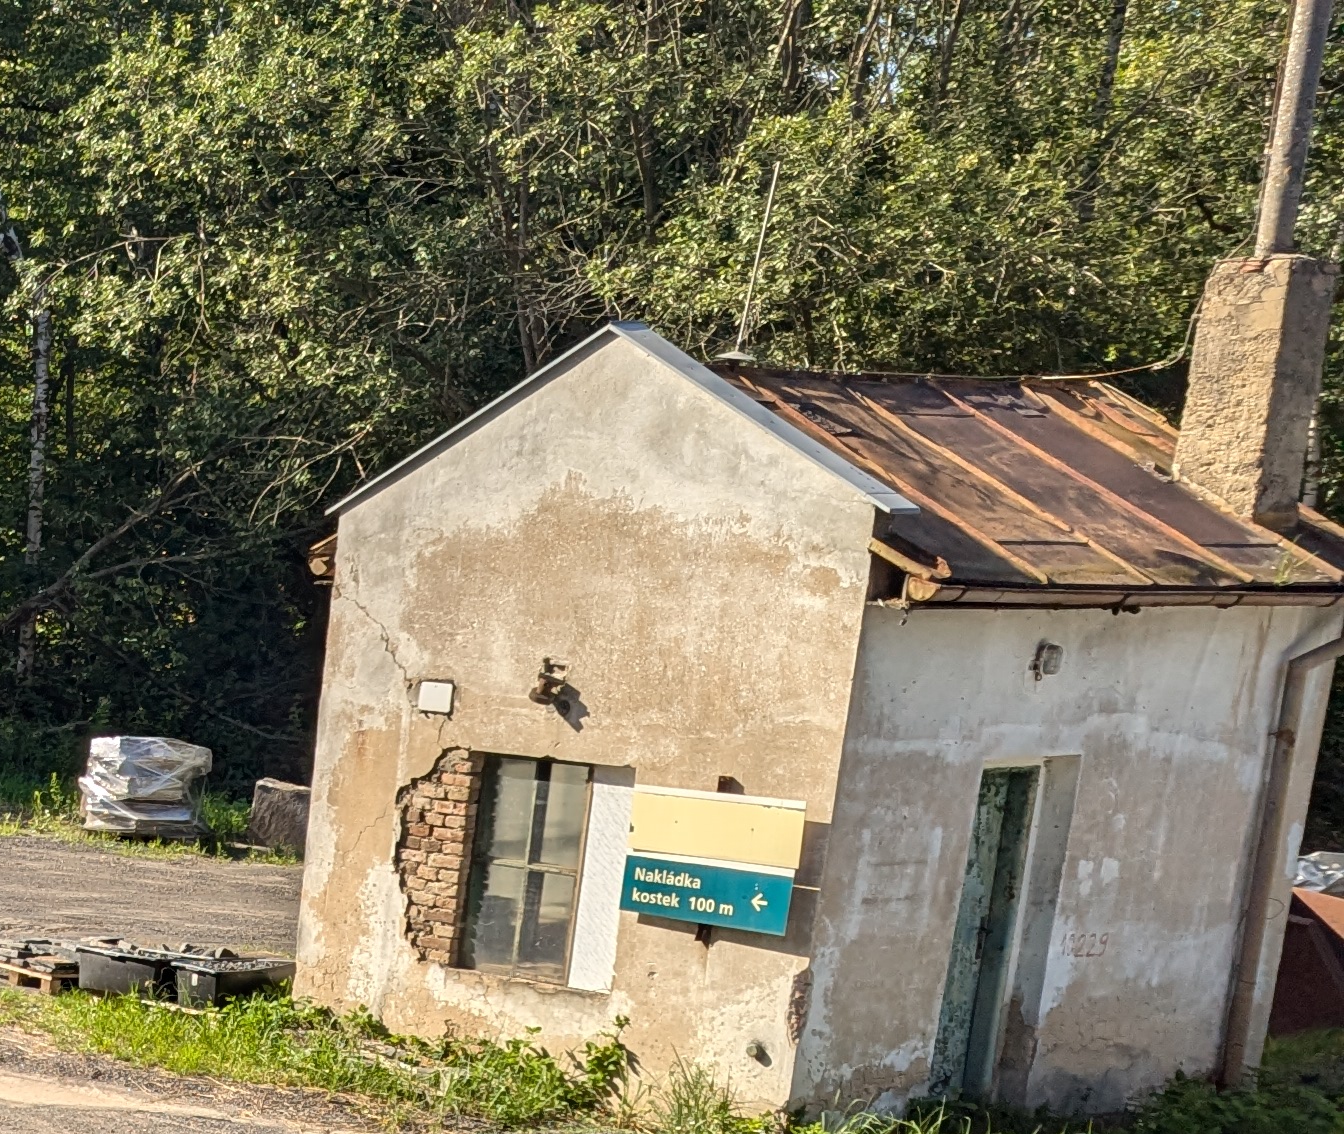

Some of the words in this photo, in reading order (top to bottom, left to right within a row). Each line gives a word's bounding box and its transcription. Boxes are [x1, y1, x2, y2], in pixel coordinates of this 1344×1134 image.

[634, 867, 701, 890] Nakládka
[632, 887, 680, 908] kostek
[688, 897, 715, 914] 100
[718, 902, 734, 916] m
